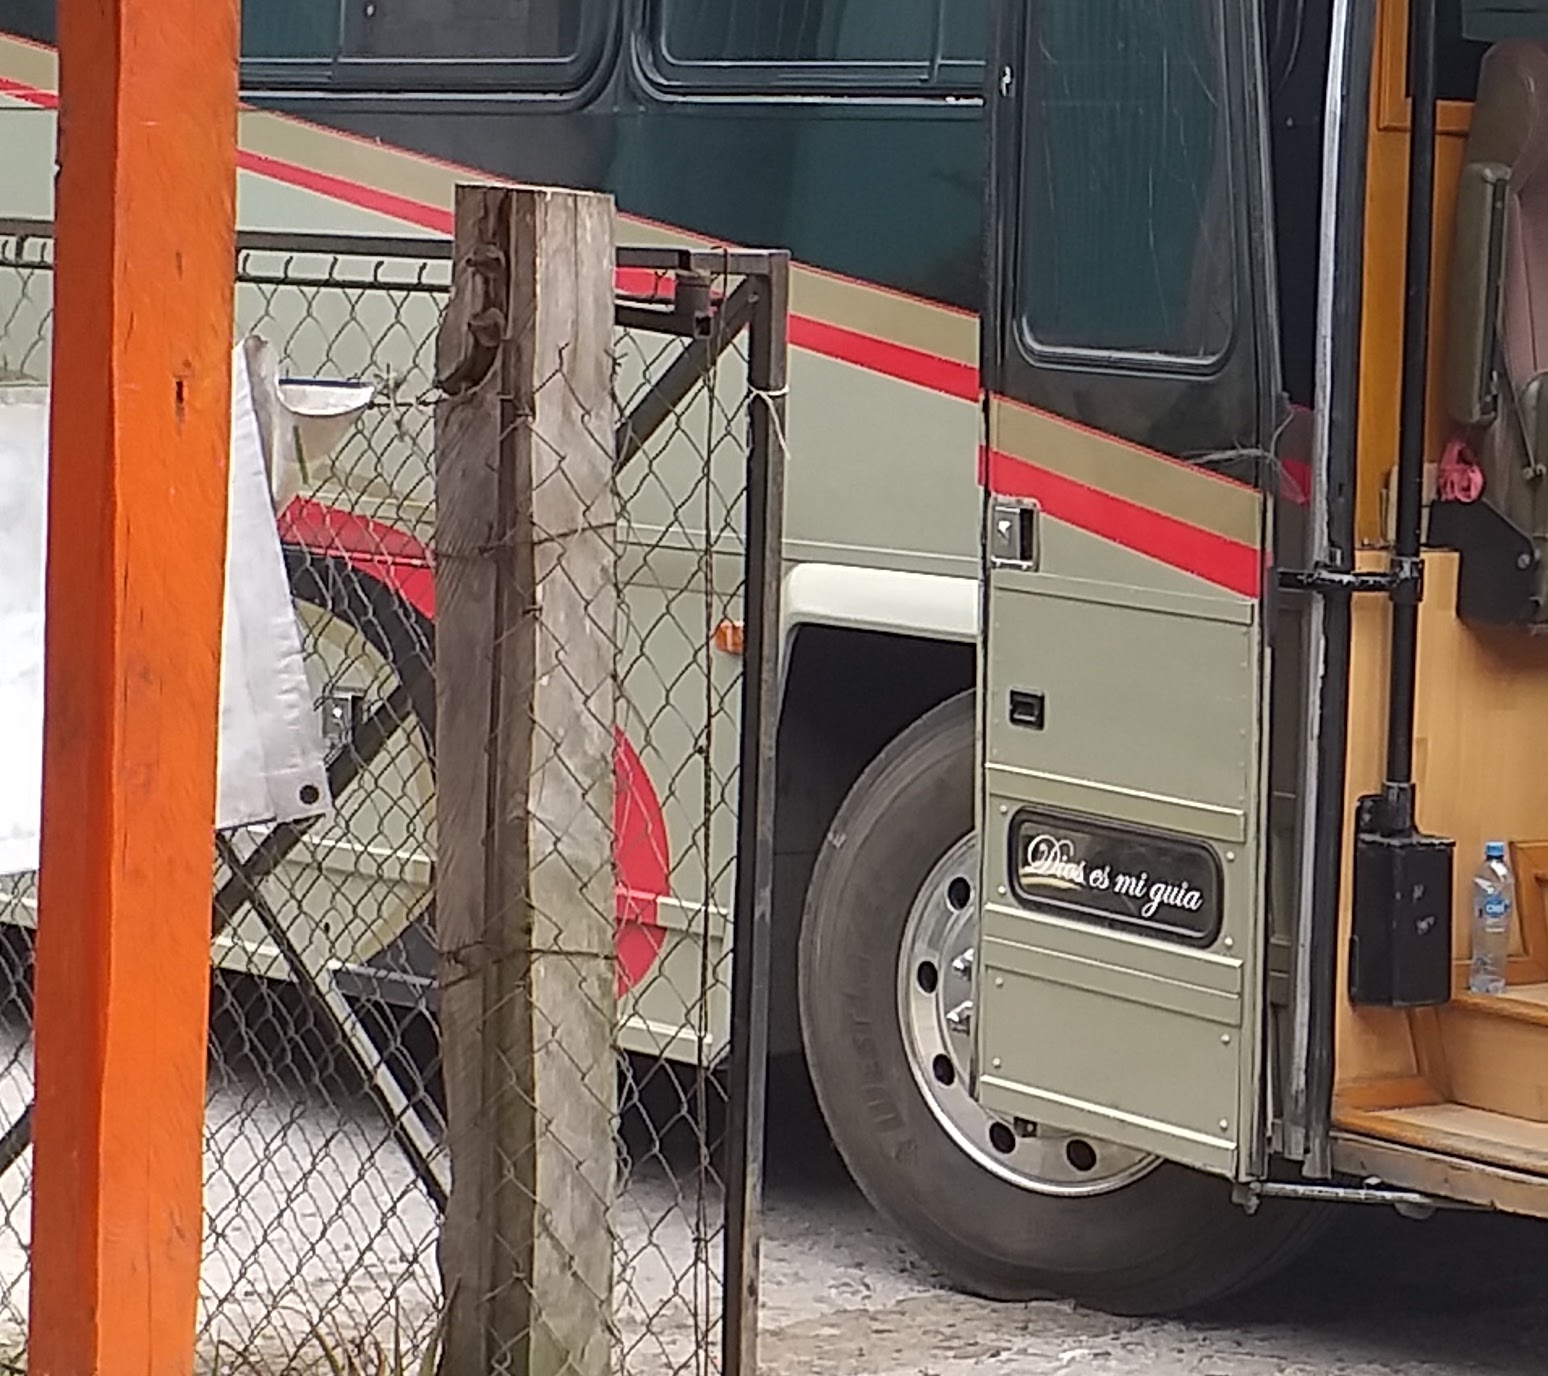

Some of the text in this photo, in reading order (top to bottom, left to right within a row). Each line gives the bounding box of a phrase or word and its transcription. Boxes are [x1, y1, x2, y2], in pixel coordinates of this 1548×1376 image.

[1022, 834, 1087, 885] Dios
[1089, 865, 1111, 890] es
[1114, 872, 1148, 898] mi
